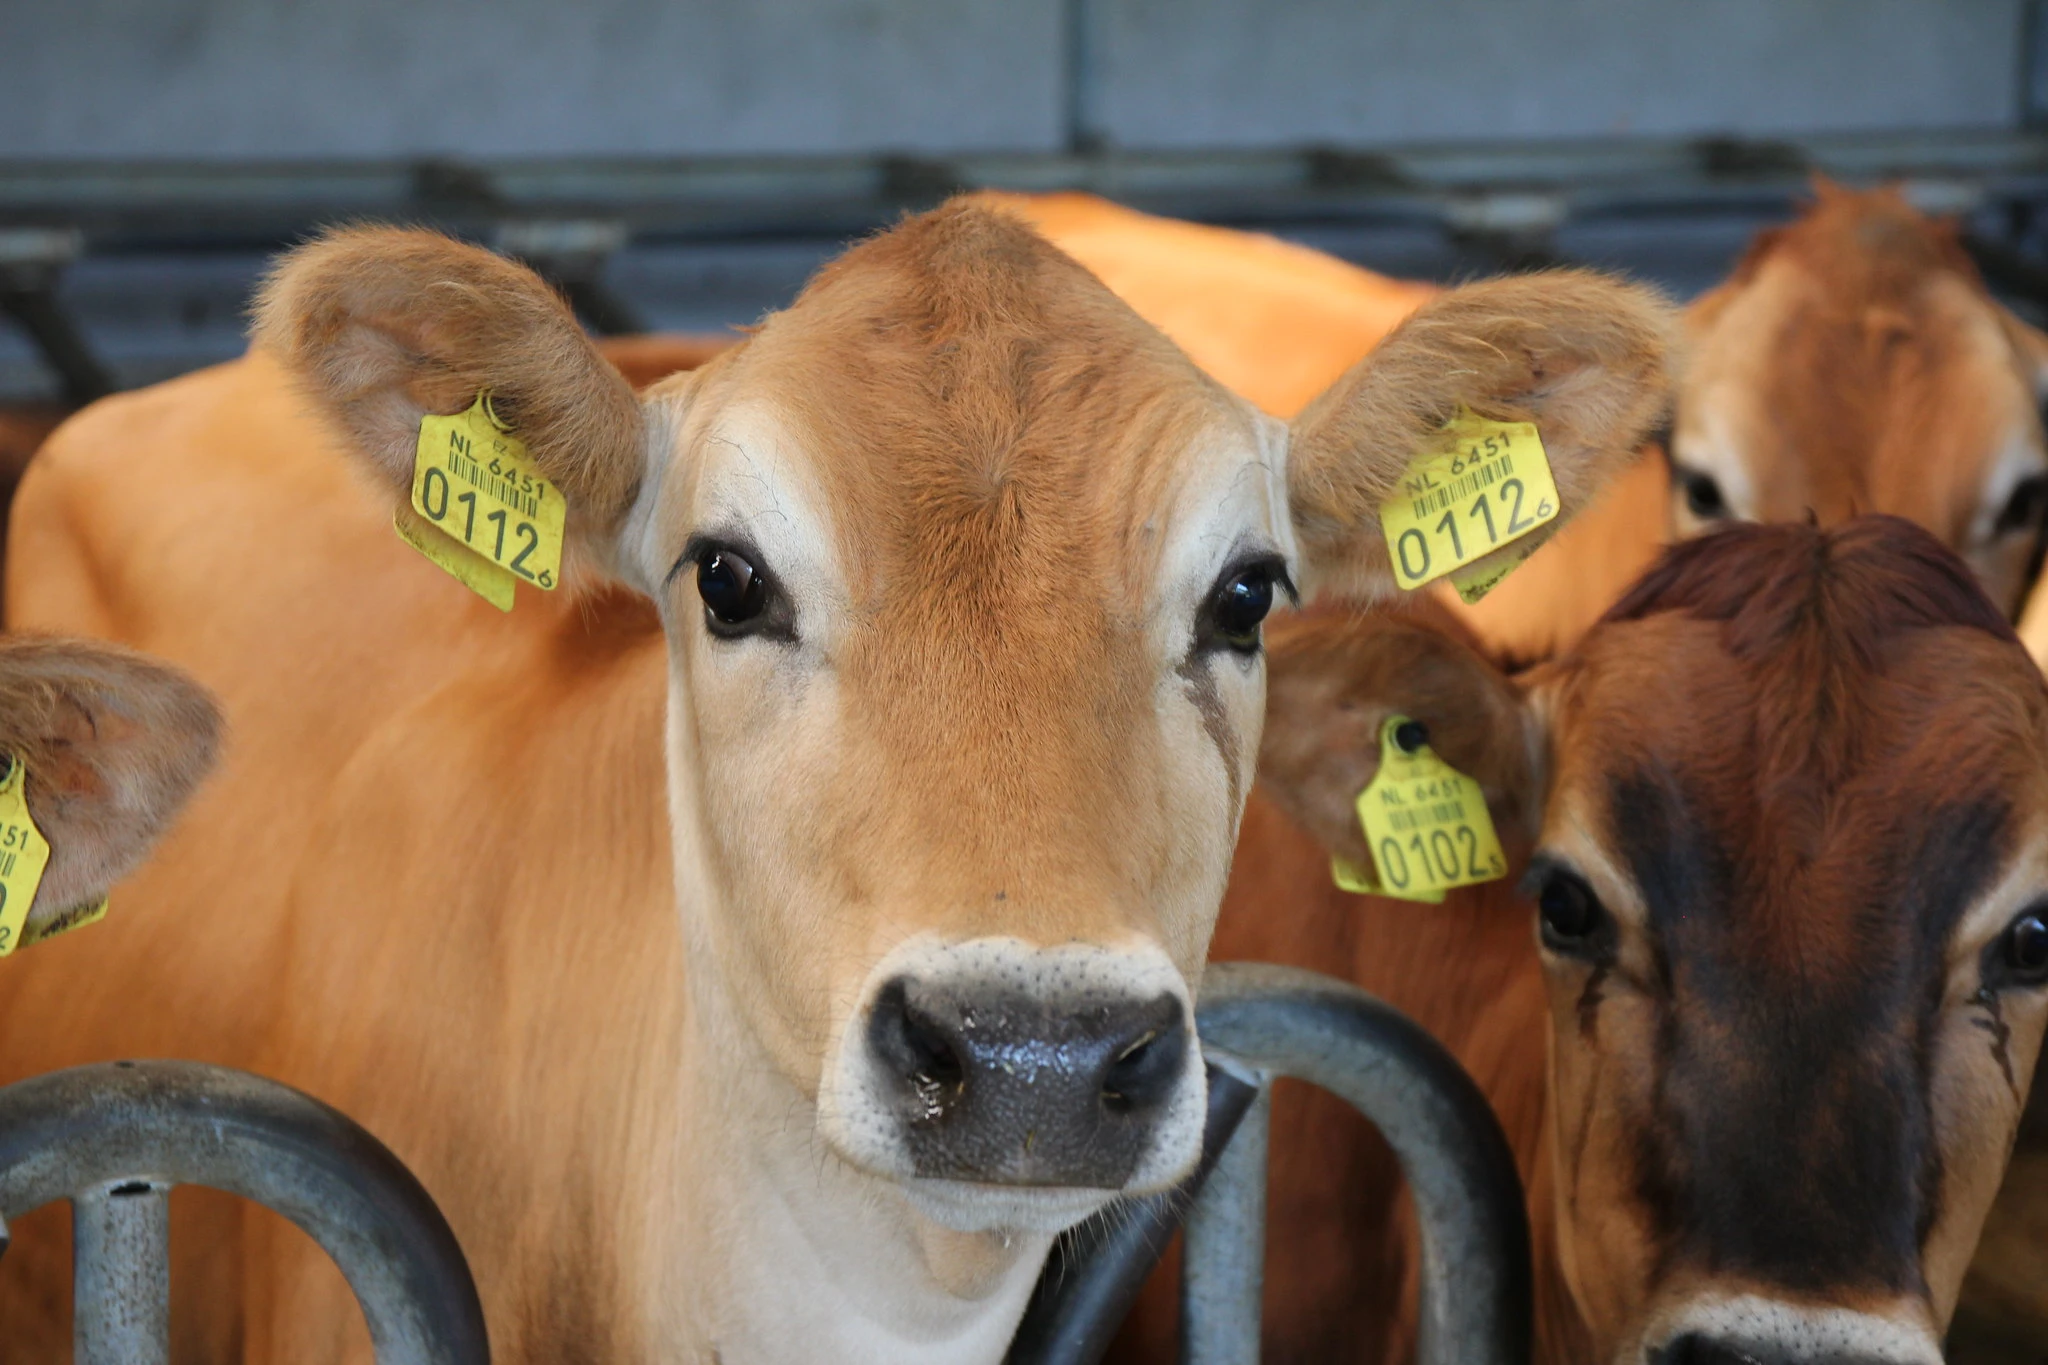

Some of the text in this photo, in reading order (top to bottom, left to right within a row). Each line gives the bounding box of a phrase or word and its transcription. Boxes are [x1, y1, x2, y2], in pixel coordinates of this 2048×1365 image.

[450, 429, 478, 463] NL
[489, 458, 545, 500] 6451
[1405, 431, 1510, 497] NL 6451
[422, 466, 539, 580] 0112
[1398, 478, 1535, 580] 0112
[0, 822, 28, 850] 51
[1381, 825, 1488, 889] 0102
